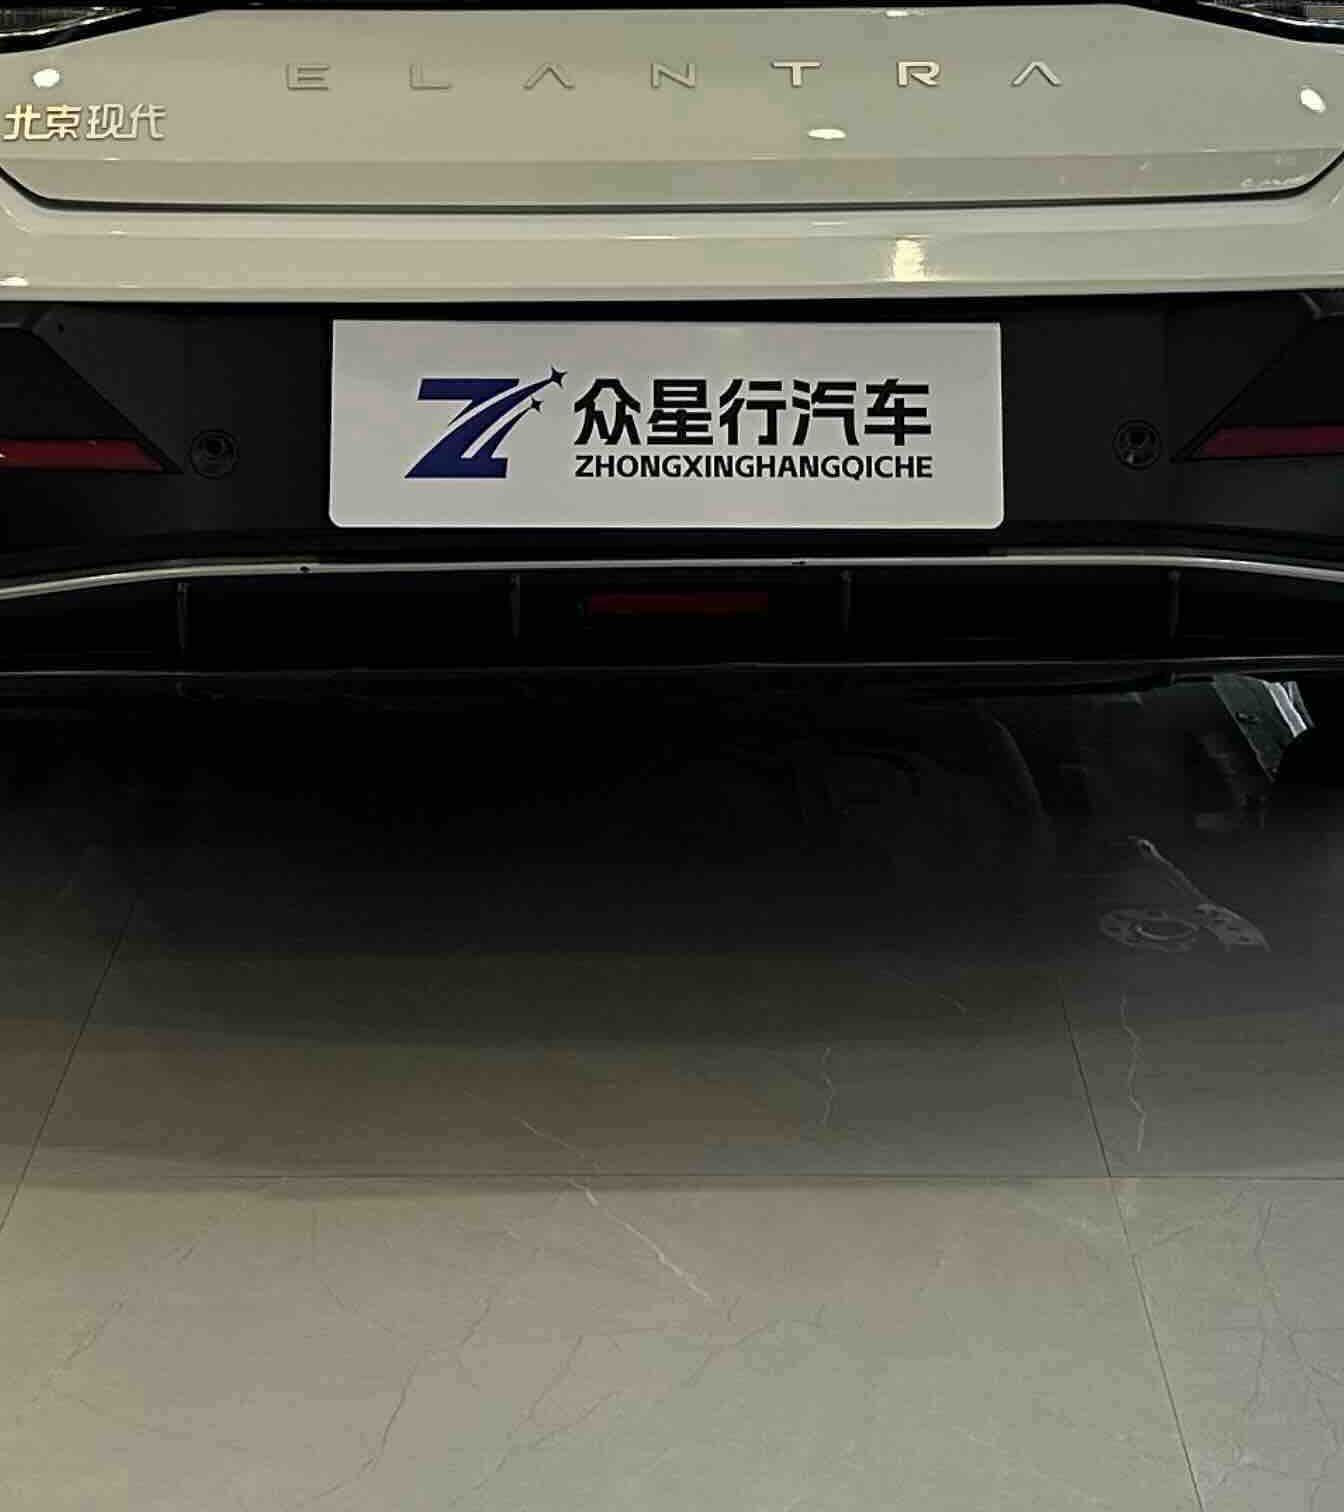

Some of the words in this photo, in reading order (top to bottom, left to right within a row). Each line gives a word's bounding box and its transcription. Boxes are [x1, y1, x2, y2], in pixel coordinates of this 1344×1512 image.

[285, 61, 1063, 90] ELANTRA
[2, 103, 167, 142] 北京现代
[573, 377, 933, 447] 众星行汽车
[575, 455, 934, 481] ZHONGXINGHANGQICHE
